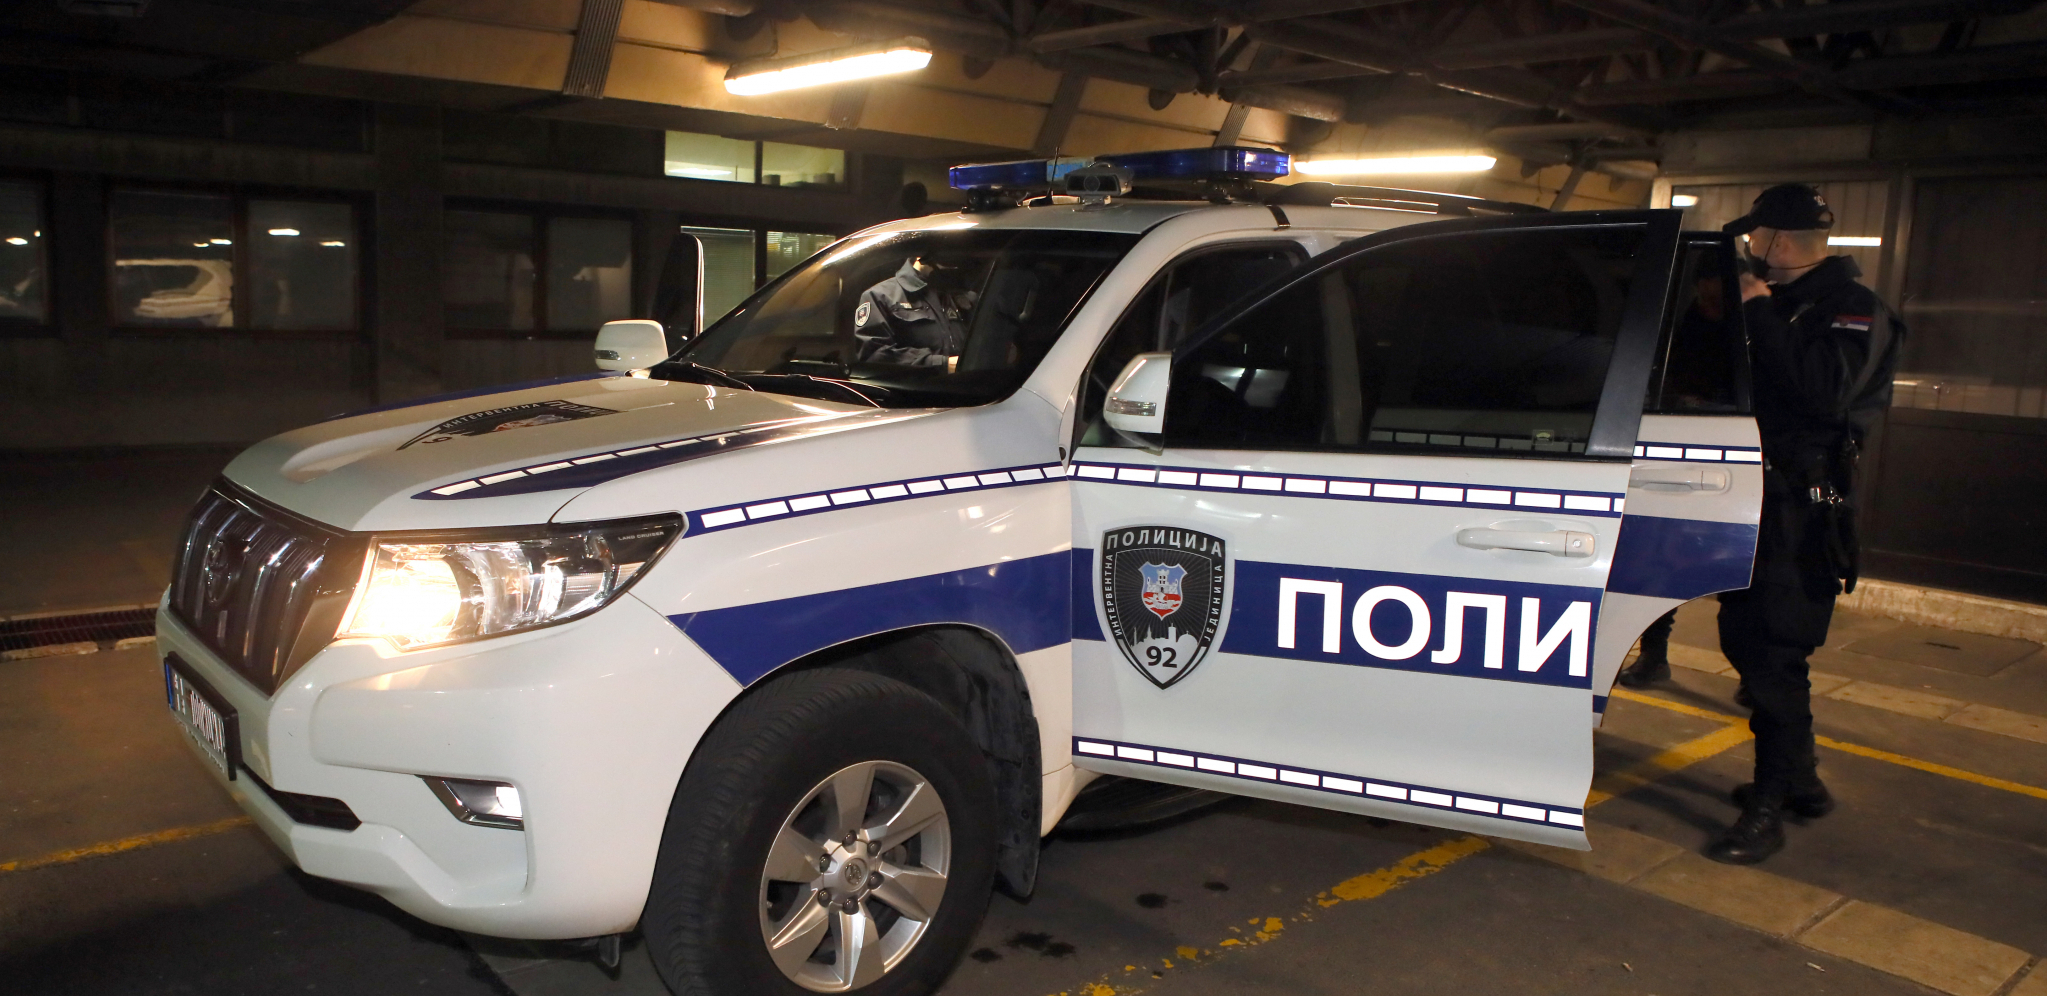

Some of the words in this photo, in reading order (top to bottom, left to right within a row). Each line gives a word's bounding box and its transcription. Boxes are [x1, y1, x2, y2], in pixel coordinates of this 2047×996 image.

[442, 403, 540, 429] ИНТЕРВЕНТНА
[636, 531, 665, 539] CRUISER
[1106, 529, 1222, 558] ПОЛИЦИЈА
[1104, 554, 1123, 636] ИНТЕРВЕНТНА
[1203, 564, 1224, 642] ЈЕДИНИЦА
[1277, 577, 1592, 677] ПОЛИ
[1145, 645, 1178, 669] 92
